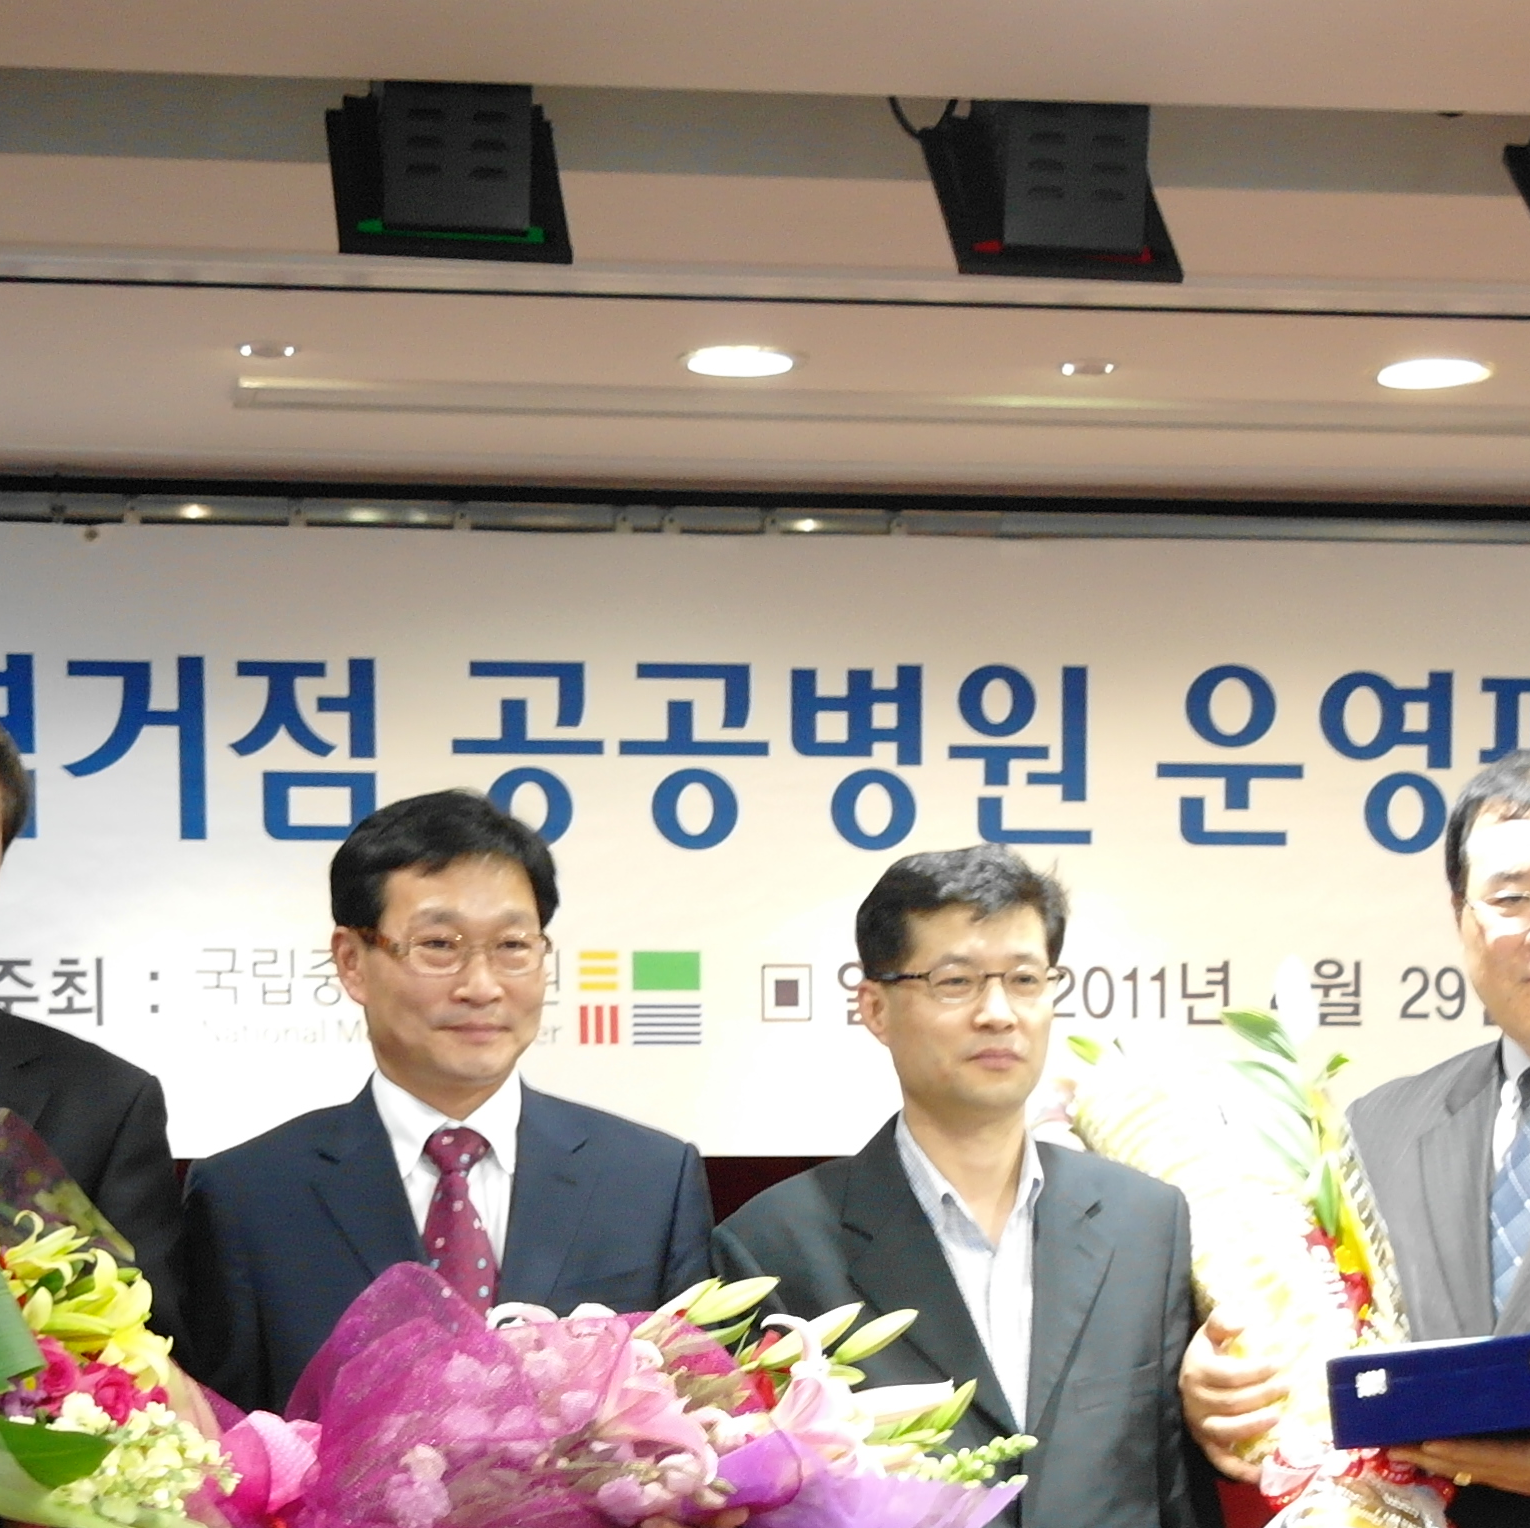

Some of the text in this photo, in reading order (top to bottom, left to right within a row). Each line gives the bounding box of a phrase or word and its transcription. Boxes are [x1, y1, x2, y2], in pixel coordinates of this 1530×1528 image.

[451, 660, 1093, 850] 공공병원
[1052, 958, 1499, 1028] 2011년 월 29
